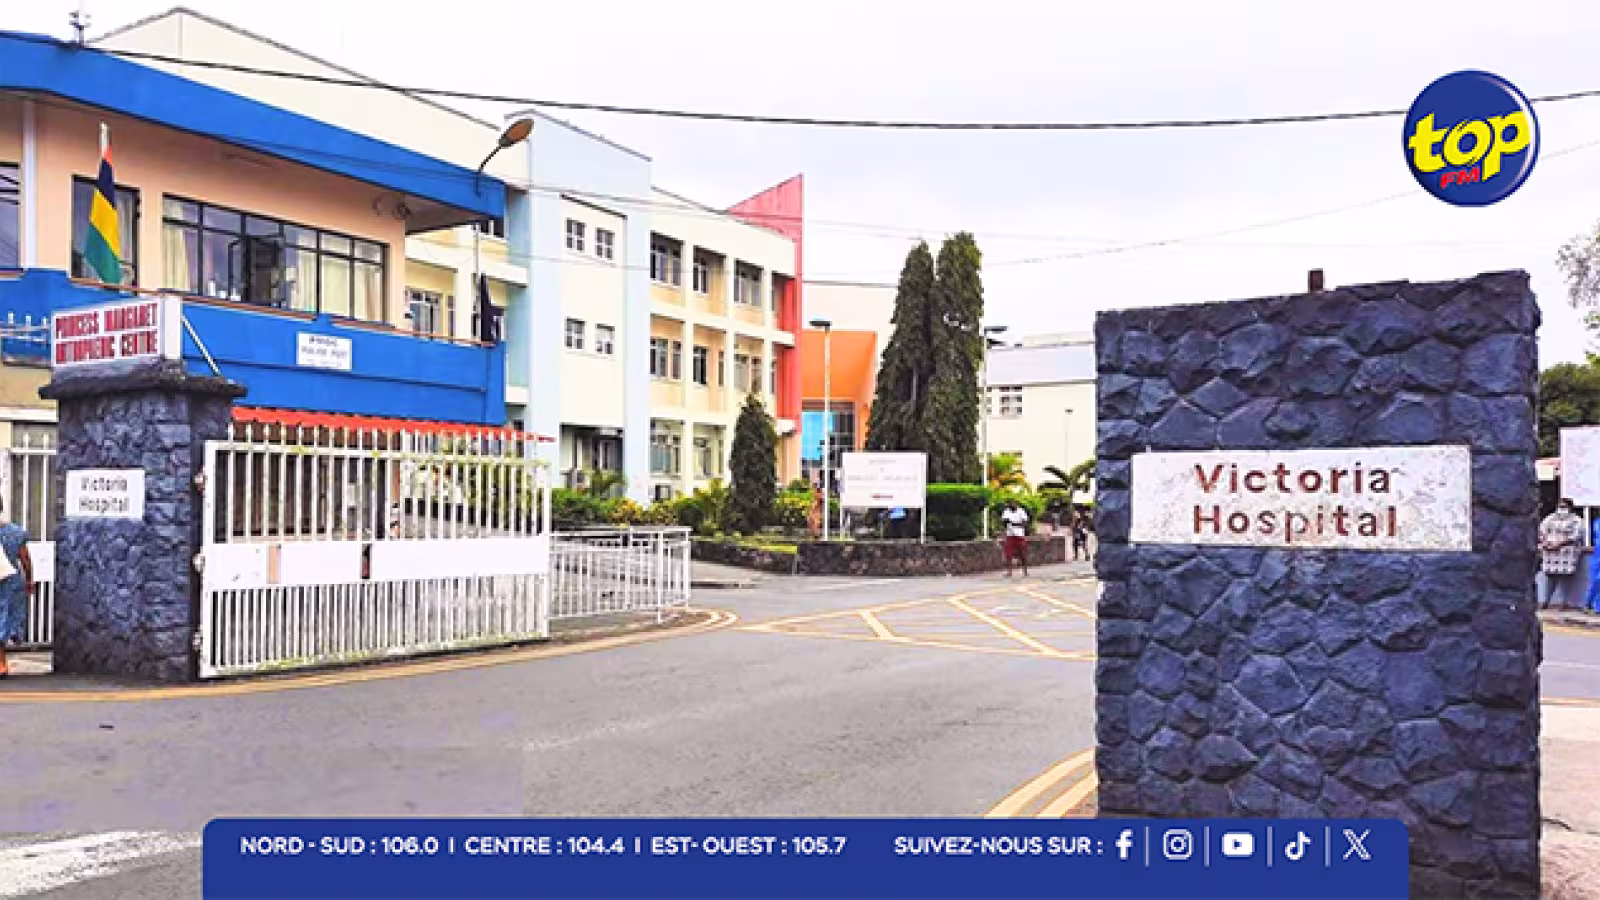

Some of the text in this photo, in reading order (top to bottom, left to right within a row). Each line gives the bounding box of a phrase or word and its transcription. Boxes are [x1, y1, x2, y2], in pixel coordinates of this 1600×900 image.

[81, 476, 128, 491] Victoria
[1193, 462, 1391, 494] Victoria
[79, 497, 129, 513] Hospital
[1193, 505, 1397, 543] Hospital
